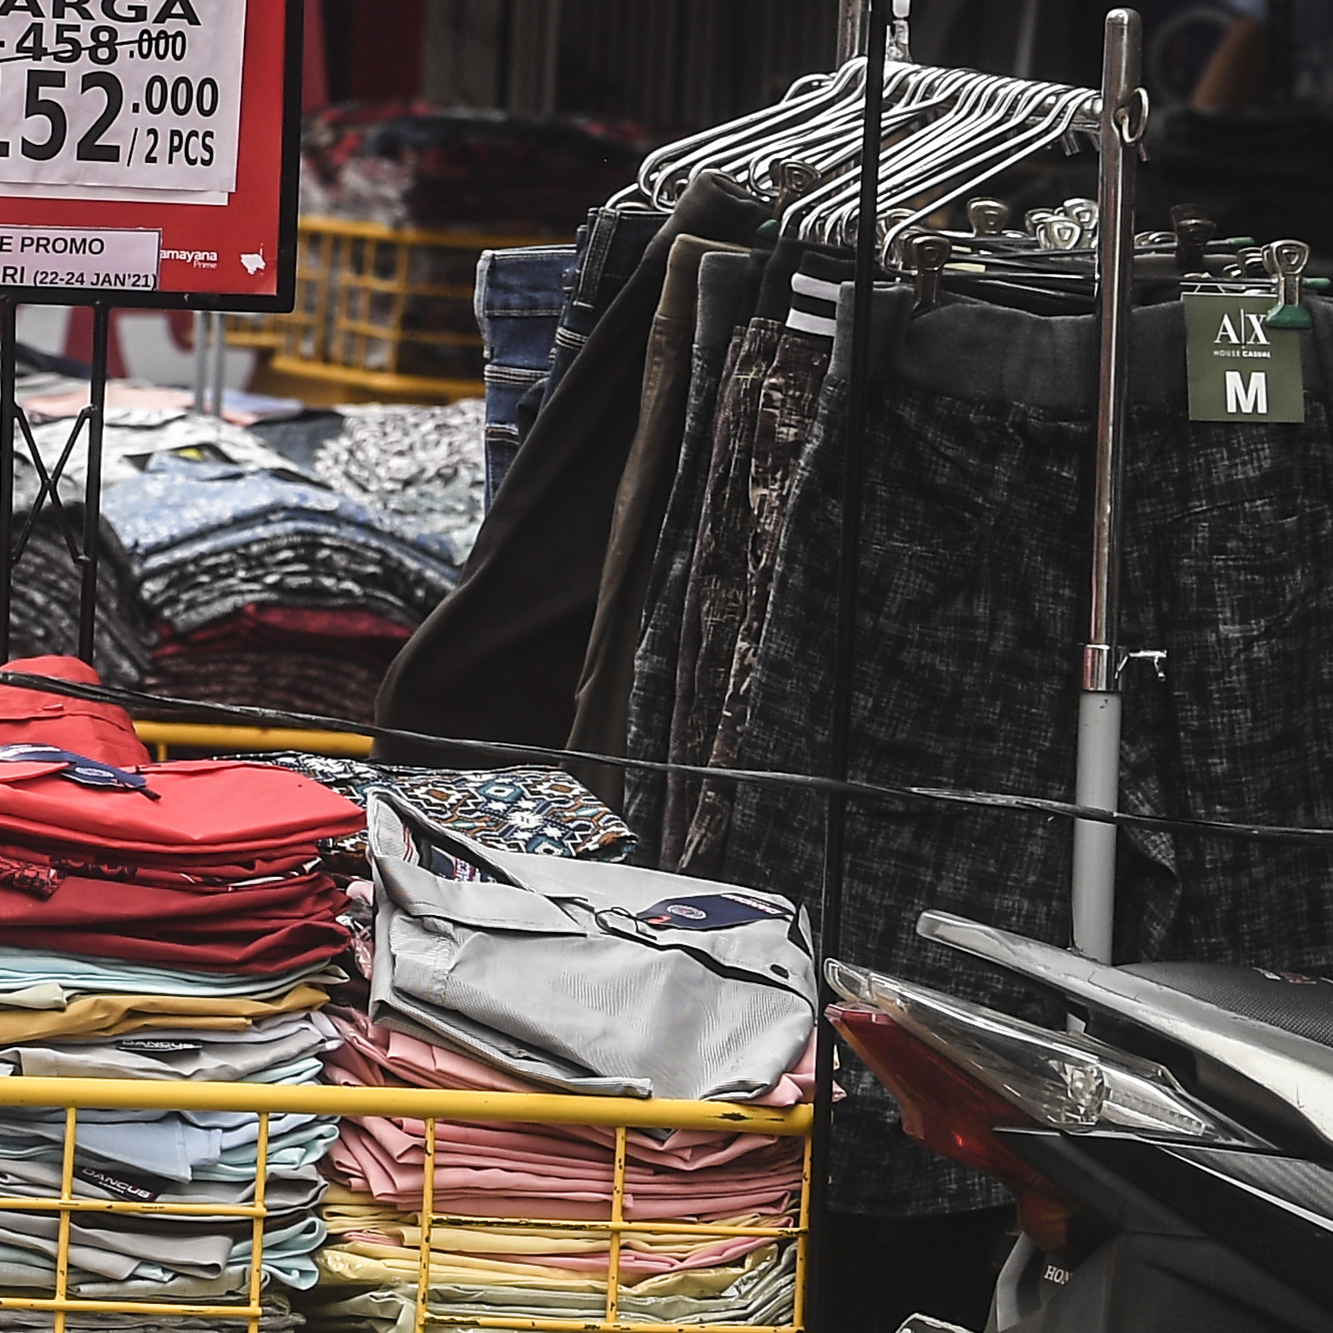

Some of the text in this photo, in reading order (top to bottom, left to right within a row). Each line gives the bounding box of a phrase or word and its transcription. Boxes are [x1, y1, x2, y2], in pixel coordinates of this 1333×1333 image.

[16, 22, 186, 65] 458.000
[168, 130, 215, 167] PCS
[20, 236, 105, 254] PROMO
[159, 249, 218, 265] amayana
[33, 270, 86, 287] (22-24
[1225, 371, 1268, 414] M
[82, 1168, 153, 1199] DANCUS
